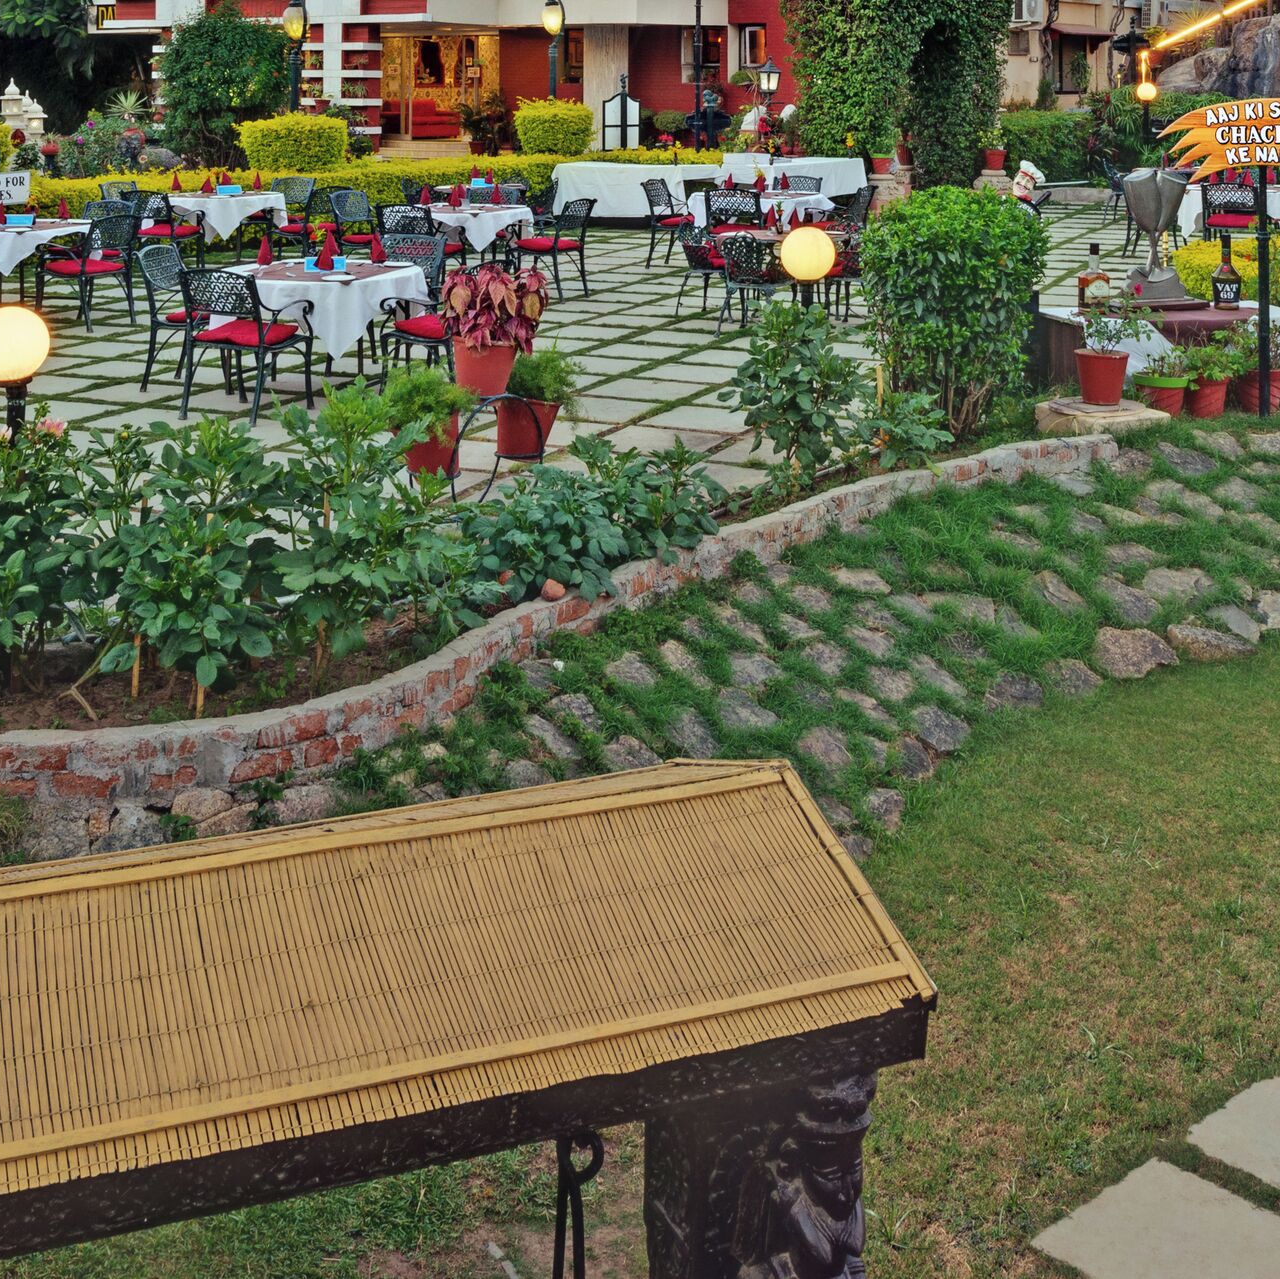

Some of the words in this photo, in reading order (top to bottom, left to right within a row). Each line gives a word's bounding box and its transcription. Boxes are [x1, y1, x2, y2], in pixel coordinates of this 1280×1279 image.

[1205, 105, 1239, 126] AAJ
[1244, 101, 1264, 119] KI
[1225, 146, 1252, 165] KE
[5, 176, 25, 188] FOR
[1216, 282, 1239, 292] VAT
[1220, 291, 1234, 300] 69
